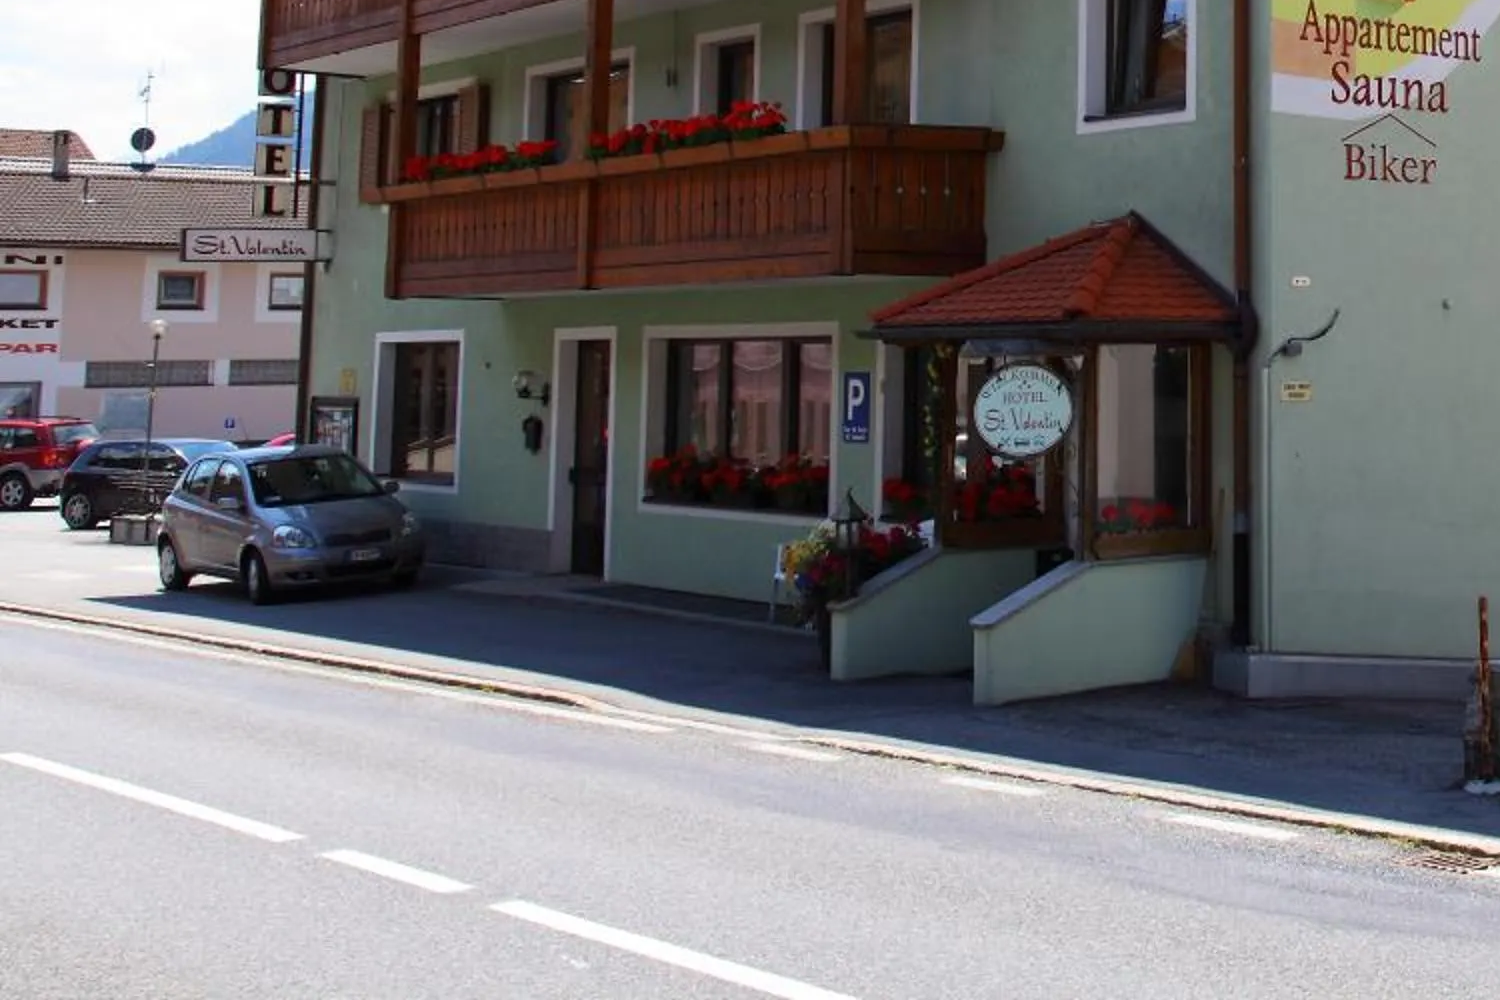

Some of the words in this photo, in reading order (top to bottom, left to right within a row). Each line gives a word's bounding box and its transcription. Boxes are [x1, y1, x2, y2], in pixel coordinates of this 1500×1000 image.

[1331, 61, 1448, 113] Sauna
[1343, 143, 1437, 184] Biker
[192, 235, 230, 256] St.
[231, 235, 307, 256] Valentin
[847, 379, 865, 421] P
[1003, 391, 1048, 405] HOTEL
